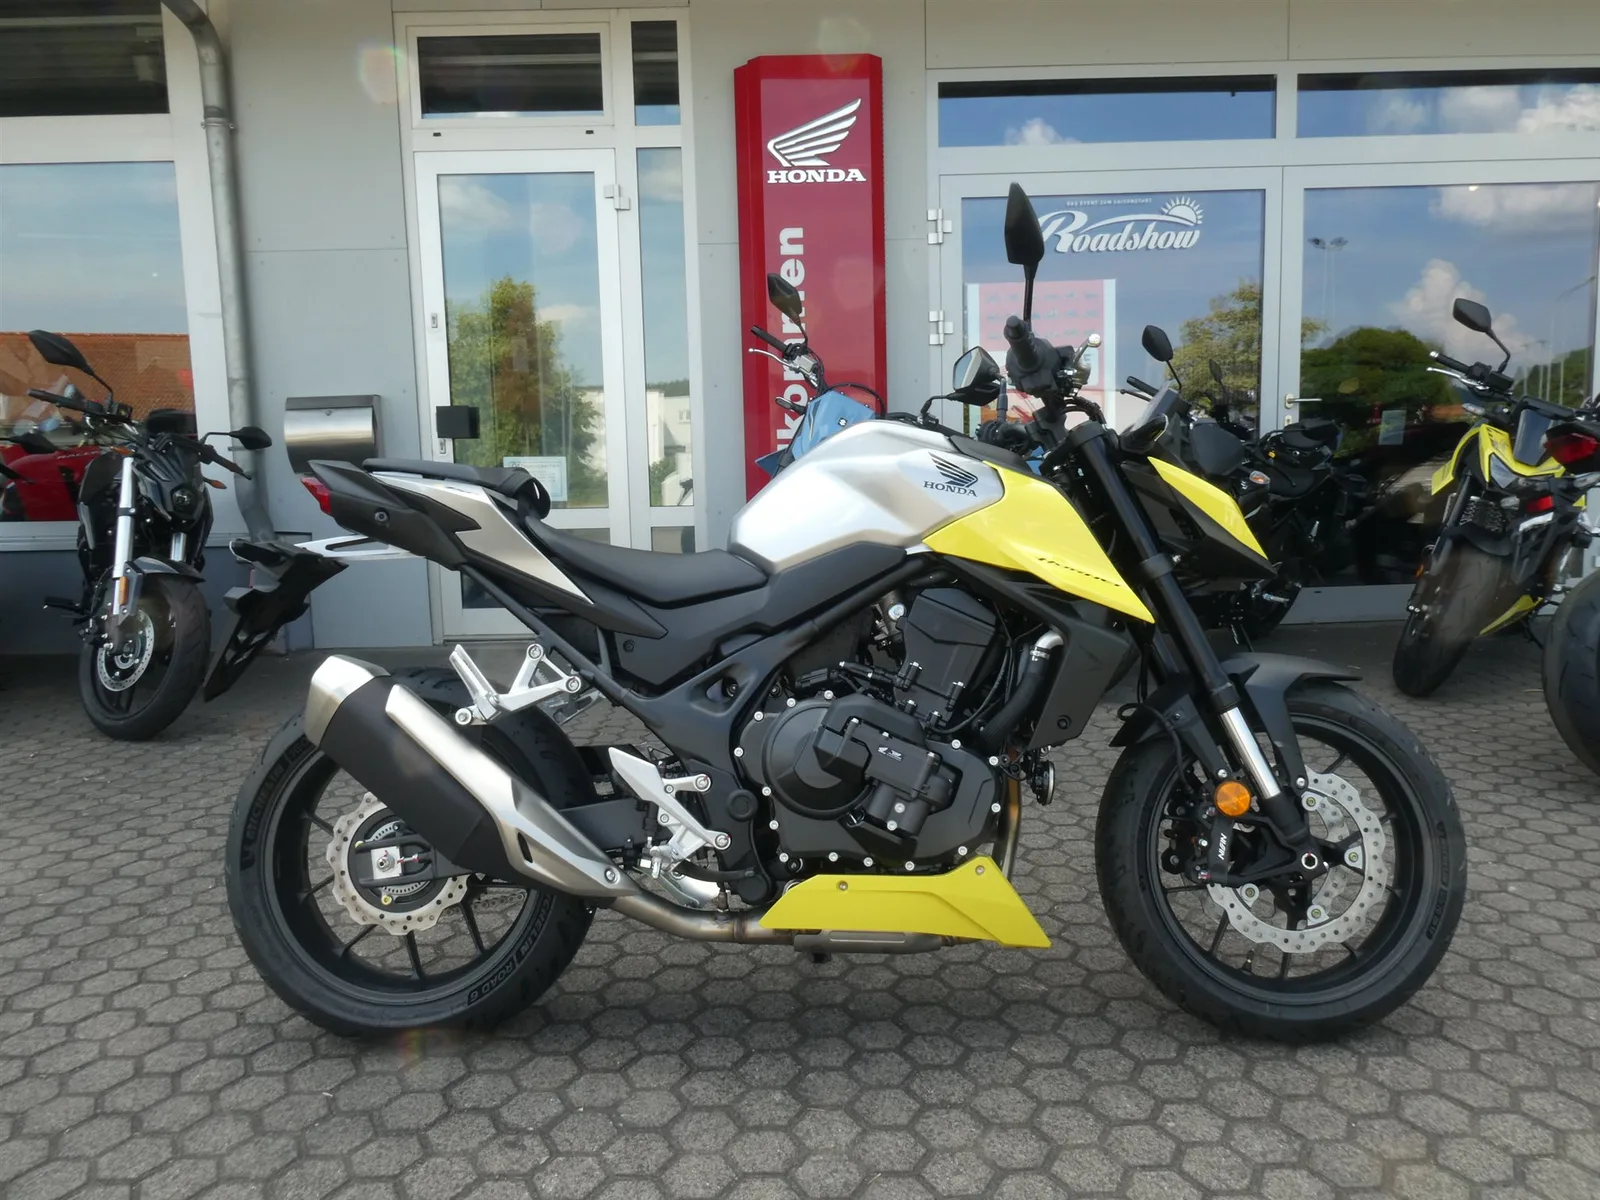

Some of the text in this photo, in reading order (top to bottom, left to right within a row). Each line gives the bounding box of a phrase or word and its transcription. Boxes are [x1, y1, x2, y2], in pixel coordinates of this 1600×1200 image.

[767, 169, 866, 184] HONDA
[1038, 210, 1200, 253] Roadshow
[923, 480, 978, 498] HONDA
[481, 960, 513, 993] ROAD
